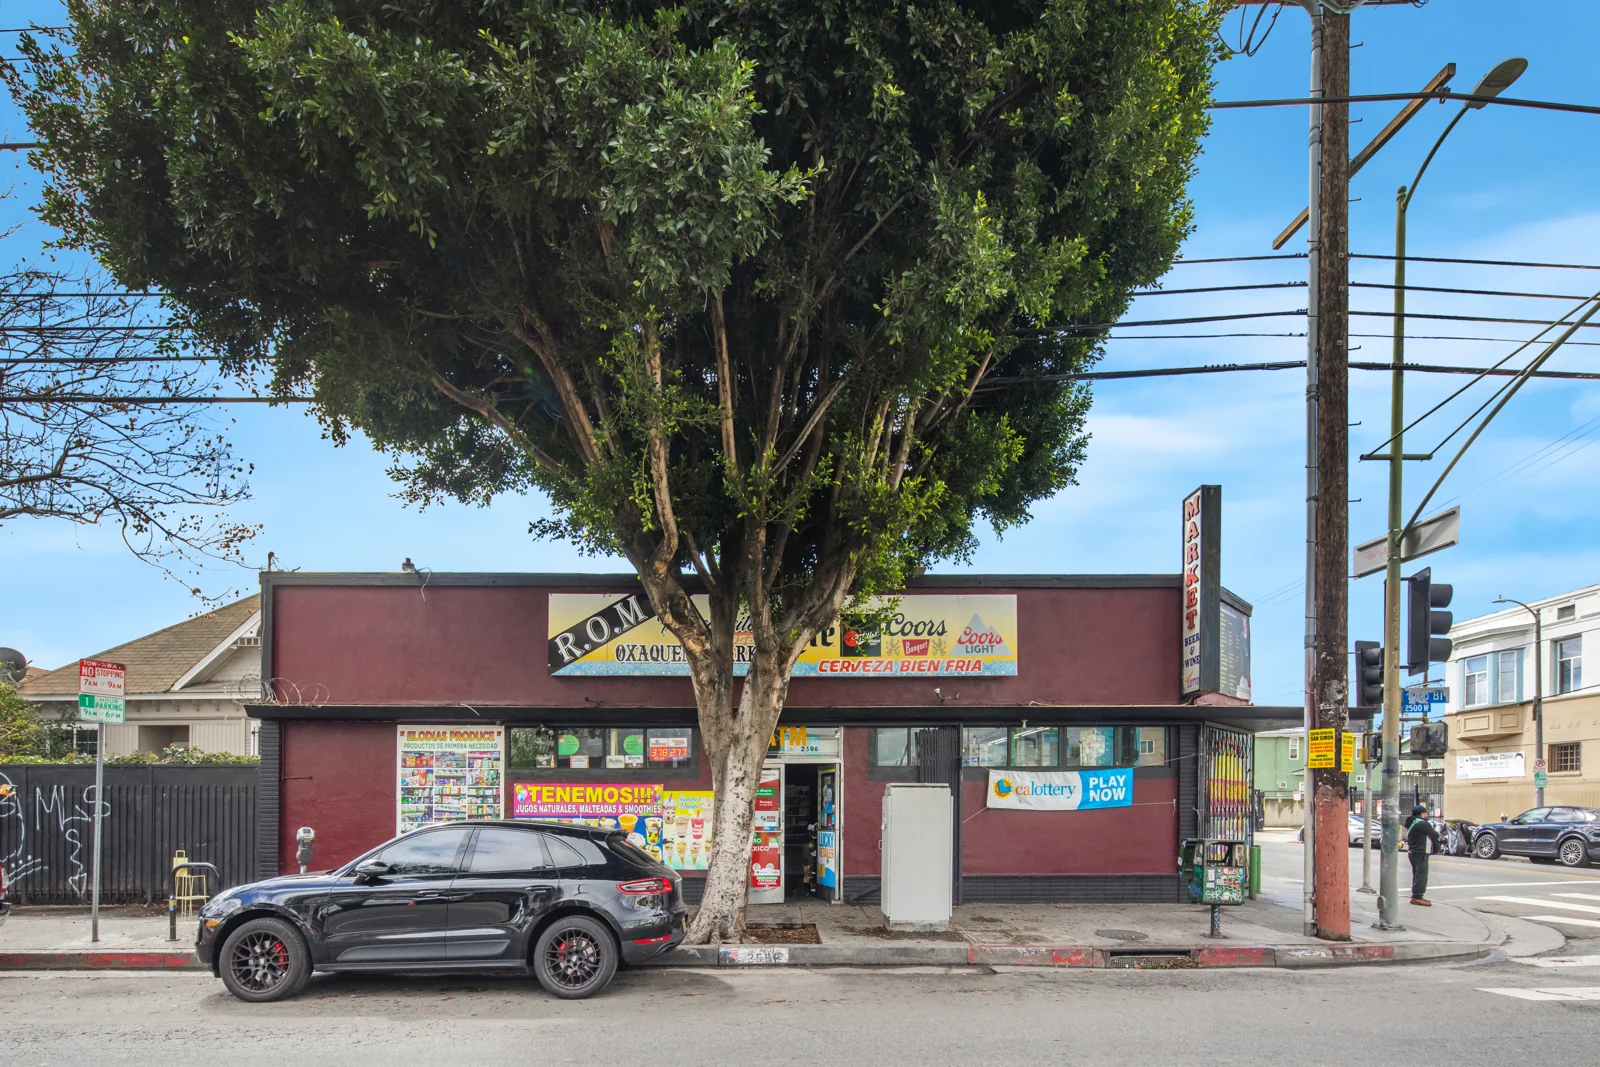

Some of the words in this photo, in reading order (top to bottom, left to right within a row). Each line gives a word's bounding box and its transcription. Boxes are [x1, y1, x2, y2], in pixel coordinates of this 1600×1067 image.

[1185, 494, 1200, 630] MARKET
[885, 613, 948, 637] Coors
[957, 626, 1004, 645] Coors
[1184, 634, 1200, 647] BEER
[905, 641, 929, 656] Banquet
[965, 644, 995, 654] LIGHT
[818, 659, 894, 673] CERVEZA
[899, 659, 941, 673] BIEN
[945, 658, 984, 672] FRIA
[1184, 656, 1200, 670] WINE
[82, 666, 94, 677] NO
[96, 669, 124, 679] STOPPING
[84, 679, 98, 687] 7AM
[107, 682, 122, 690] 9AM
[83, 708, 98, 717] 9AM
[105, 711, 121, 719] 6PM
[95, 702, 123, 712] PARKING
[1404, 704, 1422, 712] 2500
[1423, 704, 1429, 712] W
[407, 731, 447, 742] ELODIAS
[450, 731, 495, 742] PRODUCE
[652, 748, 668, 757] 378
[670, 748, 687, 757] 277
[1089, 775, 1126, 789] PLAY
[527, 786, 652, 804] TENEMOS!!!
[1015, 781, 1076, 799] calottery
[1089, 788, 1126, 802] NOW
[516, 804, 538, 814] JUGOS
[539, 804, 578, 816] NATURALES,
[579, 804, 616, 814] MALTEADAS
[618, 804, 623, 814] &
[624, 804, 661, 814] SMOOTHIES
